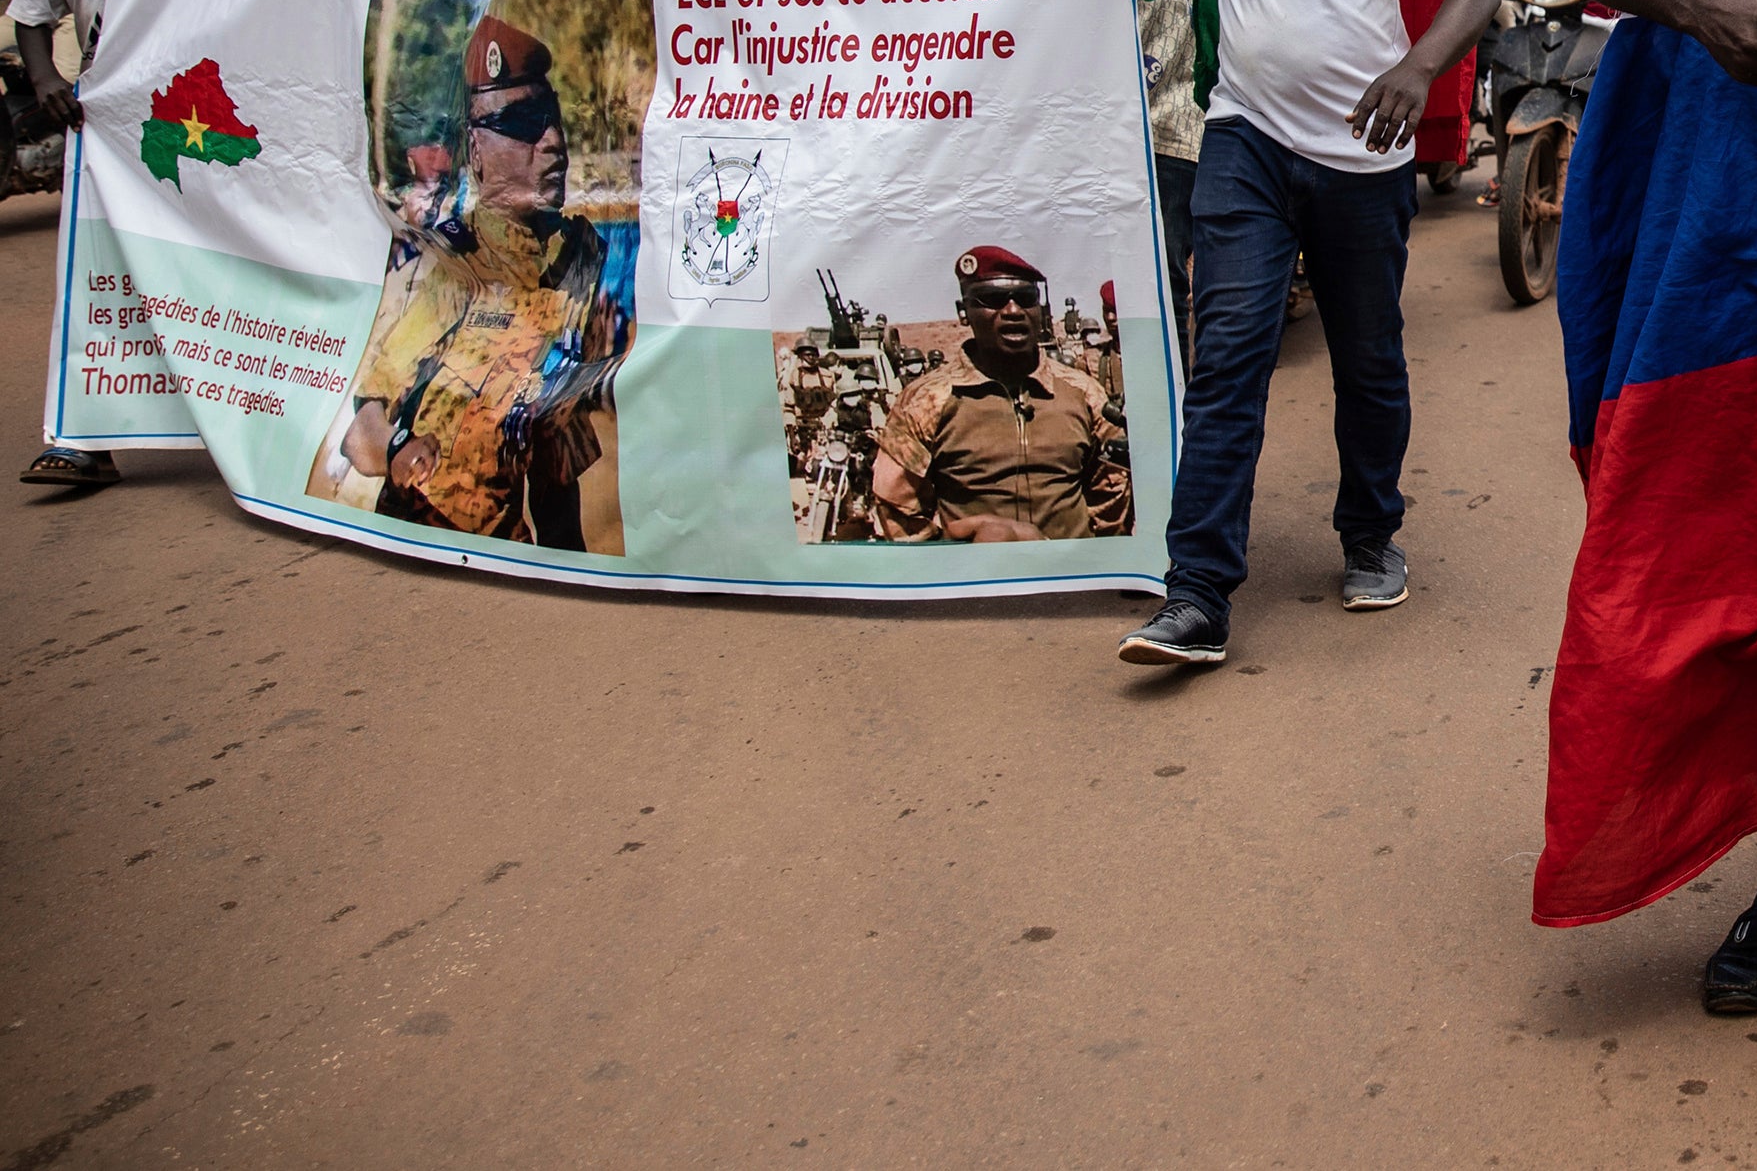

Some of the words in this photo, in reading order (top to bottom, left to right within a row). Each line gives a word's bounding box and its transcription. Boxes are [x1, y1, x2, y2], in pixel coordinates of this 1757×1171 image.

[671, 23, 724, 66] Car
[731, 18, 860, 76] l'injustice
[871, 12, 1015, 75] engendre
[667, 77, 696, 119] la
[698, 76, 779, 121] haine
[789, 83, 814, 120] et
[817, 74, 848, 119] la
[856, 74, 973, 120] division
[89, 270, 116, 292] Les
[88, 302, 113, 325] les
[201, 304, 221, 329] de
[223, 309, 287, 344] l'histoire
[288, 325, 346, 357] révèlent
[85, 336, 116, 363] qui
[172, 339, 212, 362] mais
[213, 348, 232, 367] ce
[234, 352, 267, 376] sont
[268, 355, 289, 381] les
[288, 363, 347, 394] minables
[196, 380, 224, 402] ces
[227, 384, 285, 417] tragédies.
